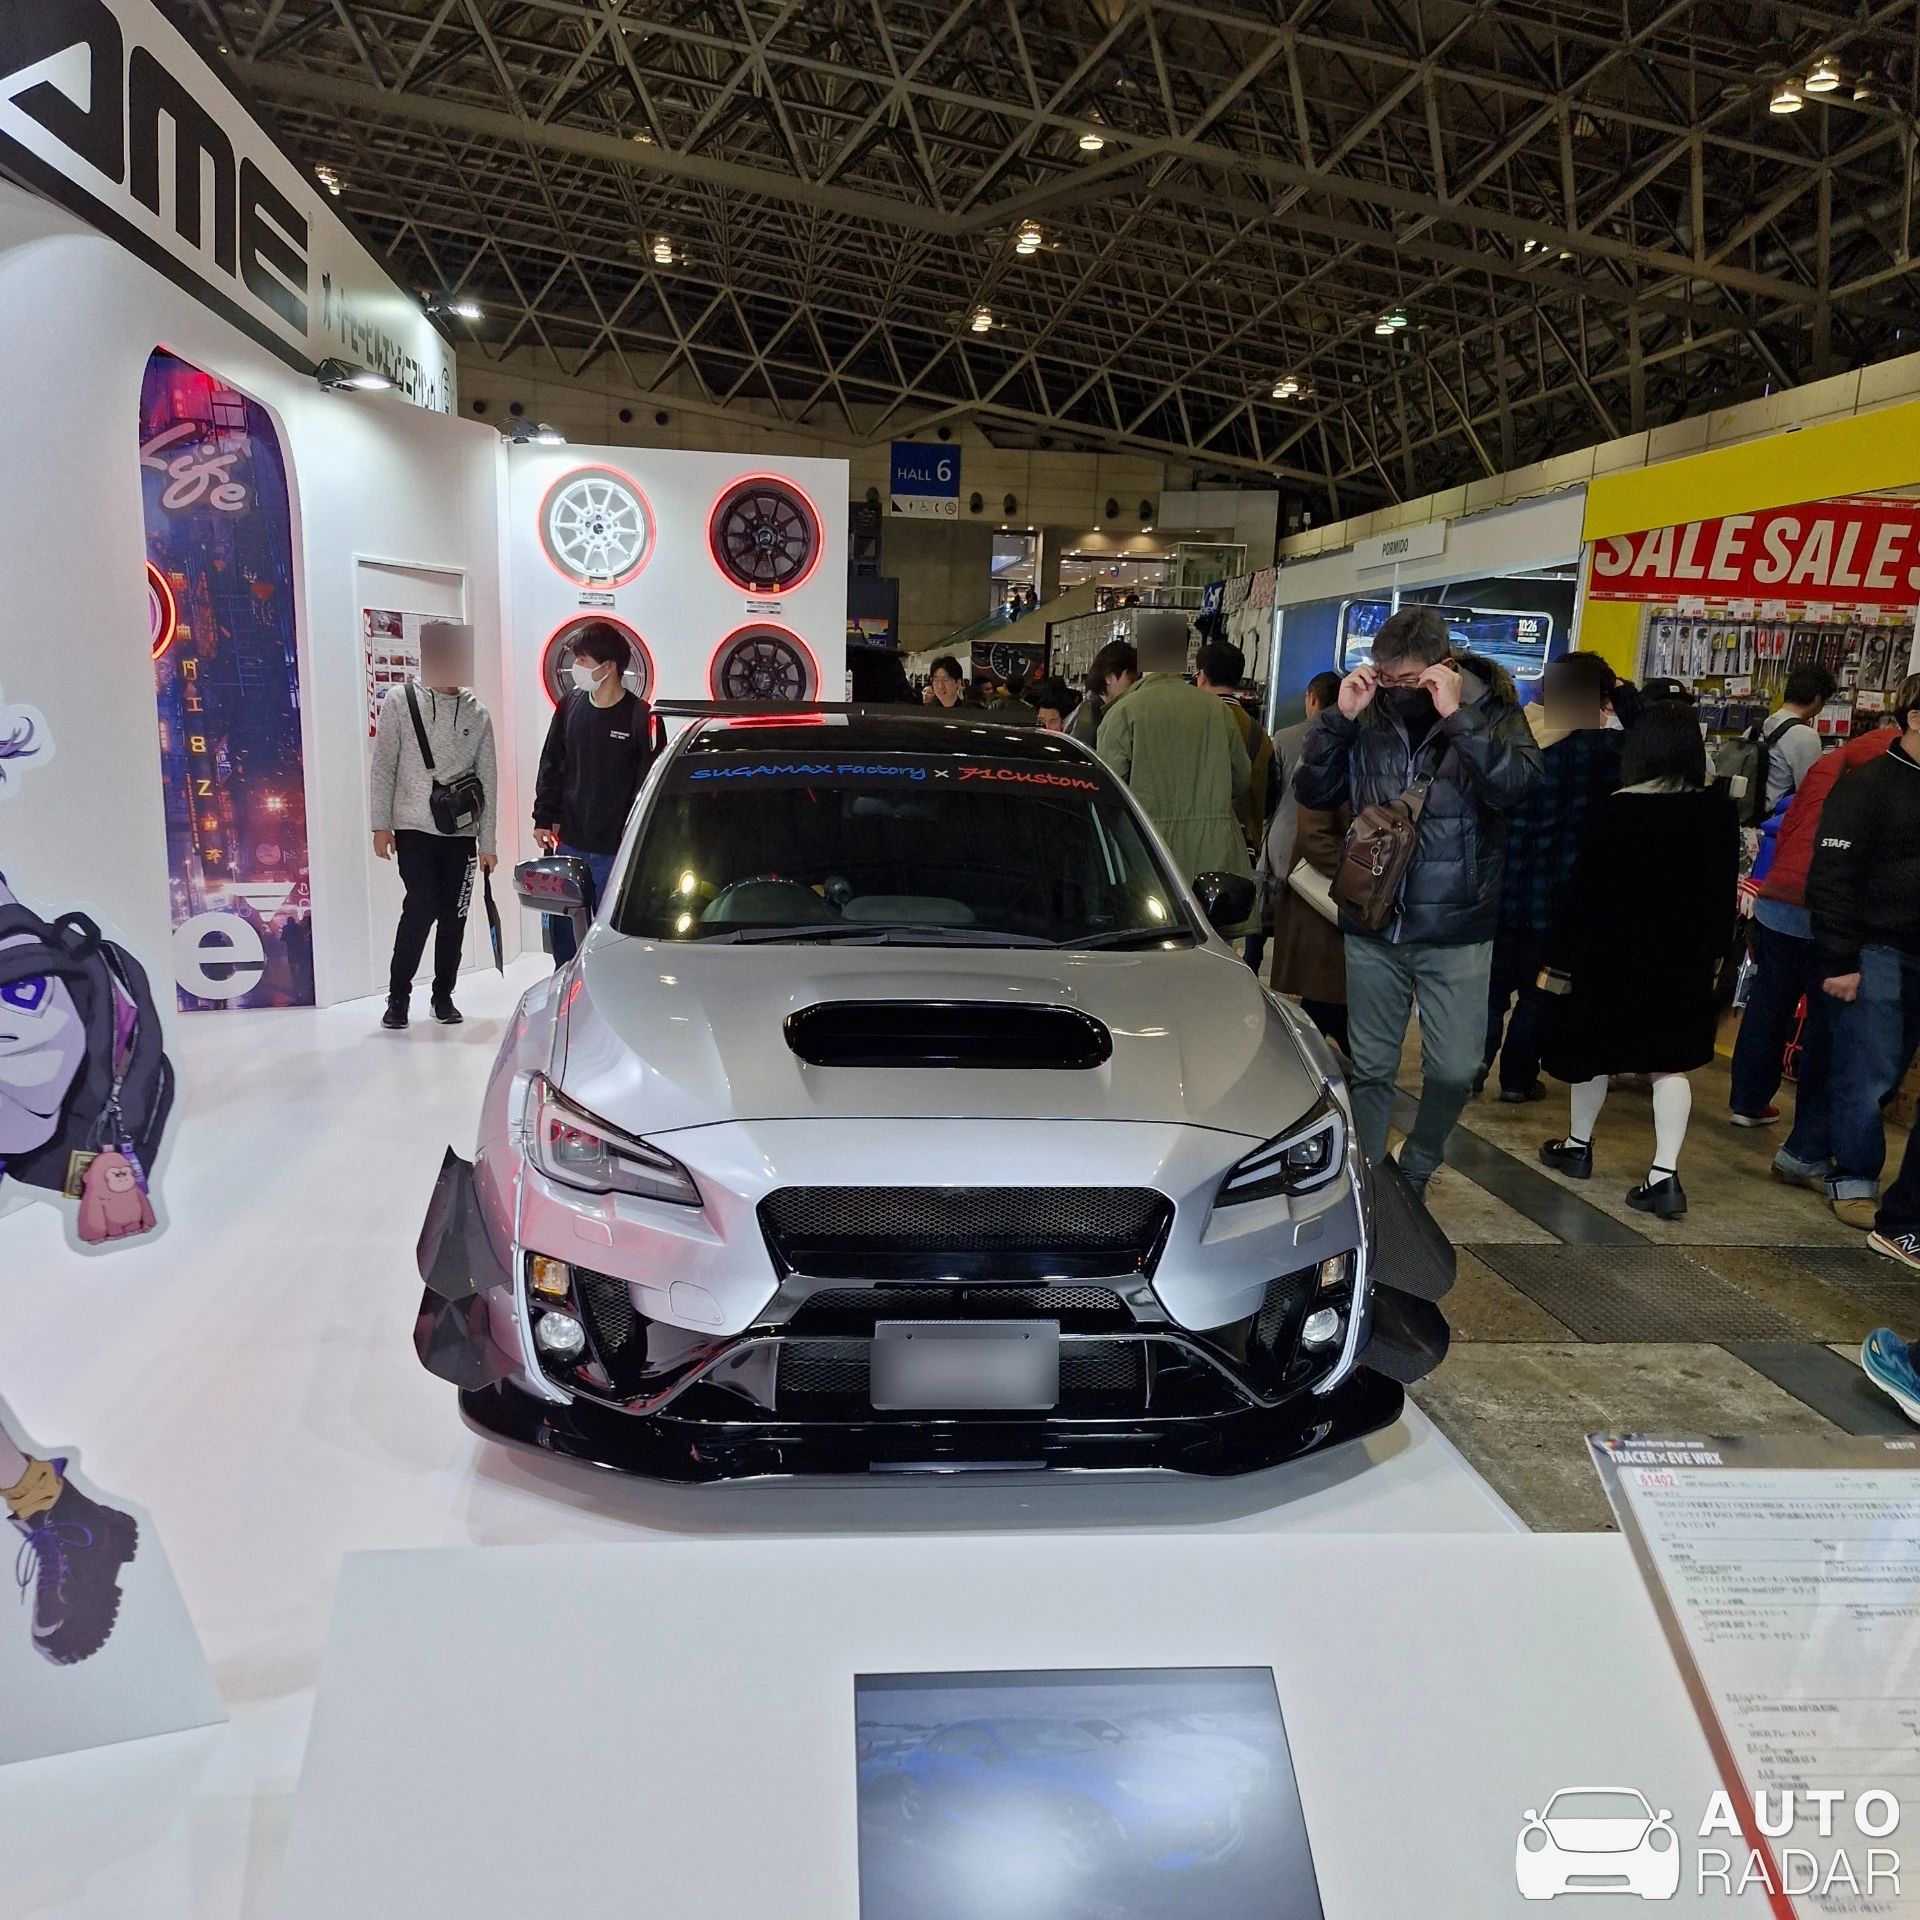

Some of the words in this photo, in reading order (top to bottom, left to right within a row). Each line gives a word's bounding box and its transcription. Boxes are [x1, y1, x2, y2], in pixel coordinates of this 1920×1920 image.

[897, 468, 932, 481] HALL
[936, 459, 952, 482] 6
[1382, 538, 1409, 557] PORMIDO
[1753, 516, 1912, 589] SALE
[690, 763, 831, 780] SUGAMAX
[836, 763, 926, 782] Factory
[1821, 837, 1851, 850] STAFF
[1693, 1451, 1724, 1465] WRX
[1639, 1473, 1676, 1487] 61402
